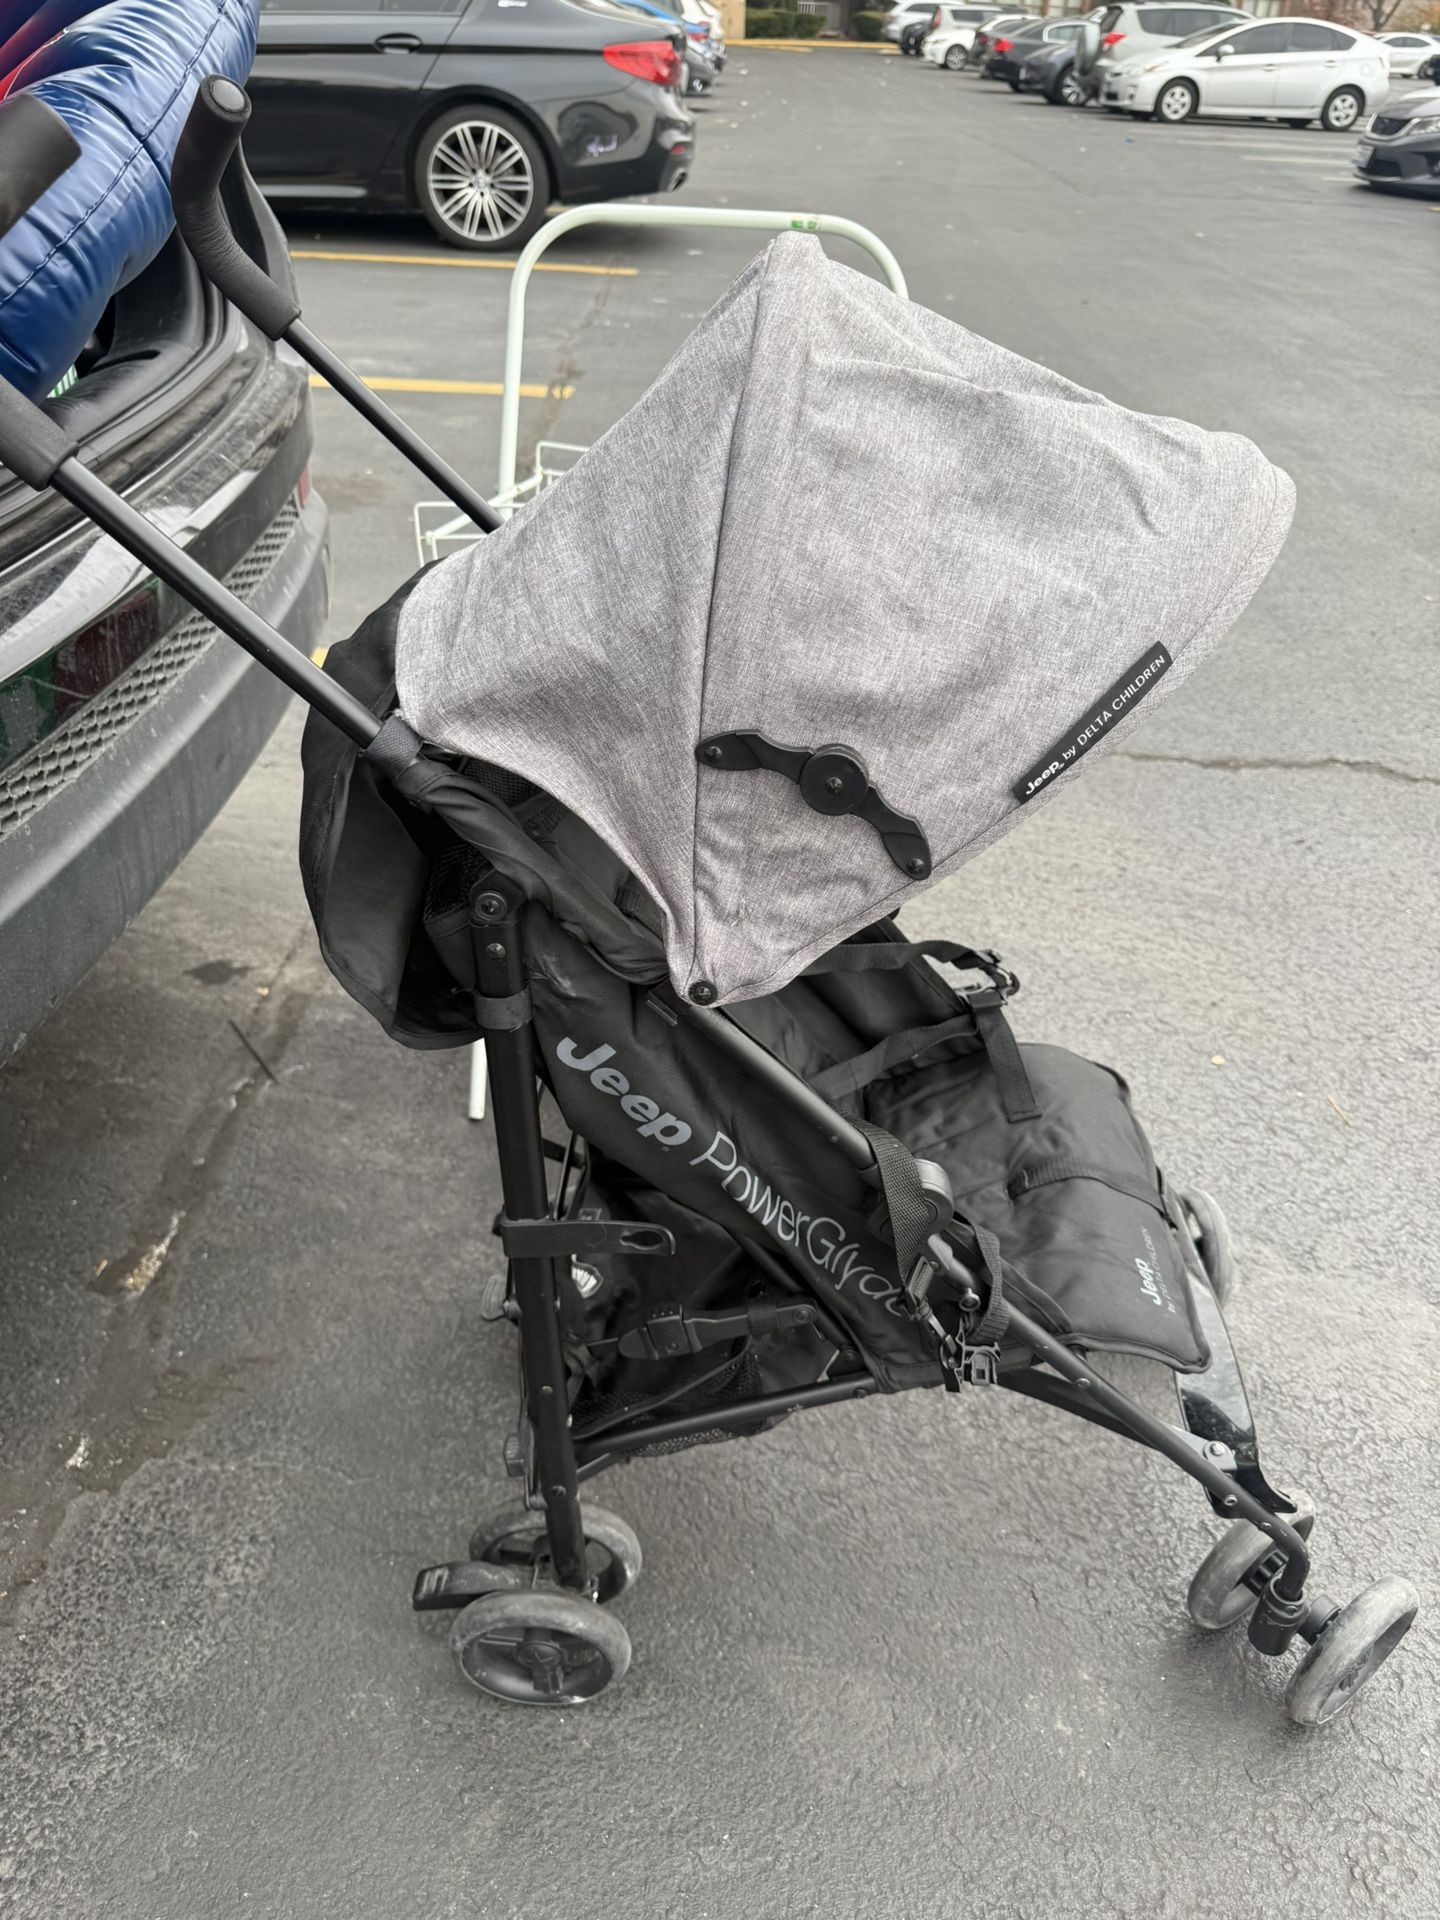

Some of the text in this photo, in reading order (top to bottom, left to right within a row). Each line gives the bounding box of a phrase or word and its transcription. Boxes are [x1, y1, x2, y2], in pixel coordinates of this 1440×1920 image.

[1025, 655, 1165, 796] Jeep by DELTA CHILDREN
[556, 1036, 692, 1146] Jeep
[1135, 1257, 1162, 1306] Jeep
